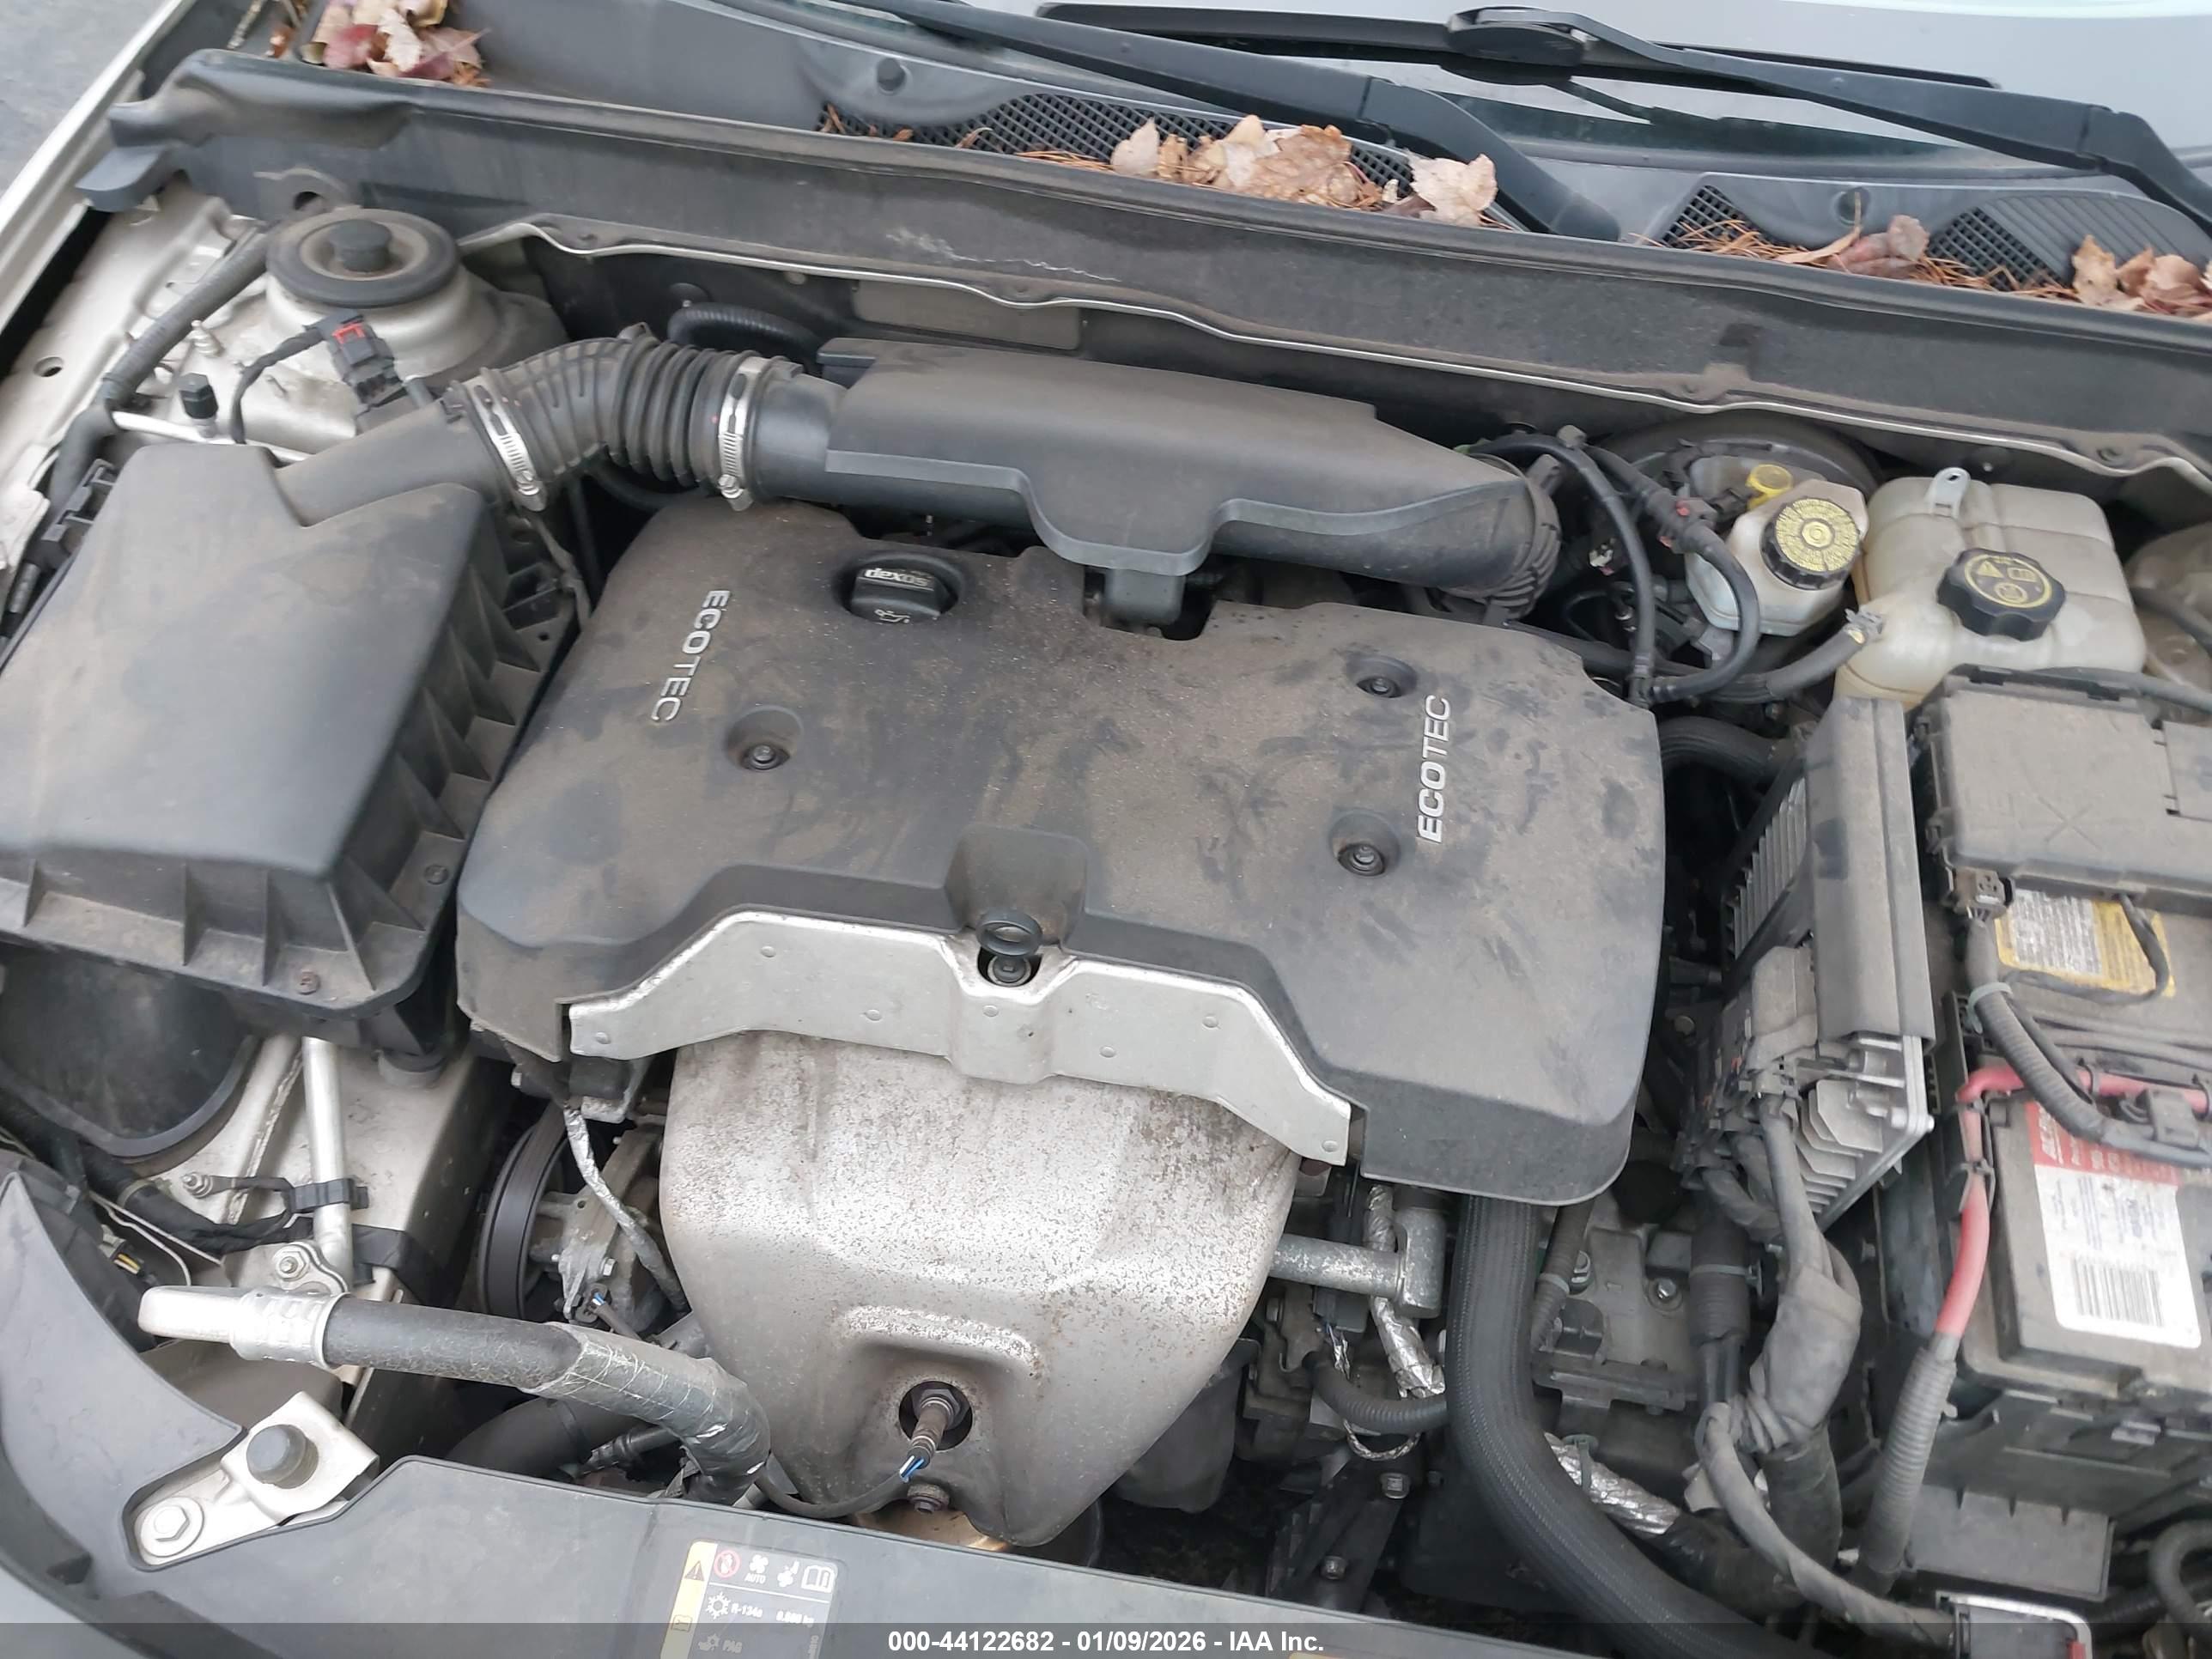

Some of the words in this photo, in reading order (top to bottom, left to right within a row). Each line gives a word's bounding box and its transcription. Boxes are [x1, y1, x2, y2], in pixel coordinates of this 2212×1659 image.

[865, 568, 929, 587] dexos
[650, 589, 732, 722] ECOTEC
[1417, 694, 1451, 844] ECOTEC
[744, 1573, 766, 1584] AUTO
[722, 1639, 743, 1654] PAG
